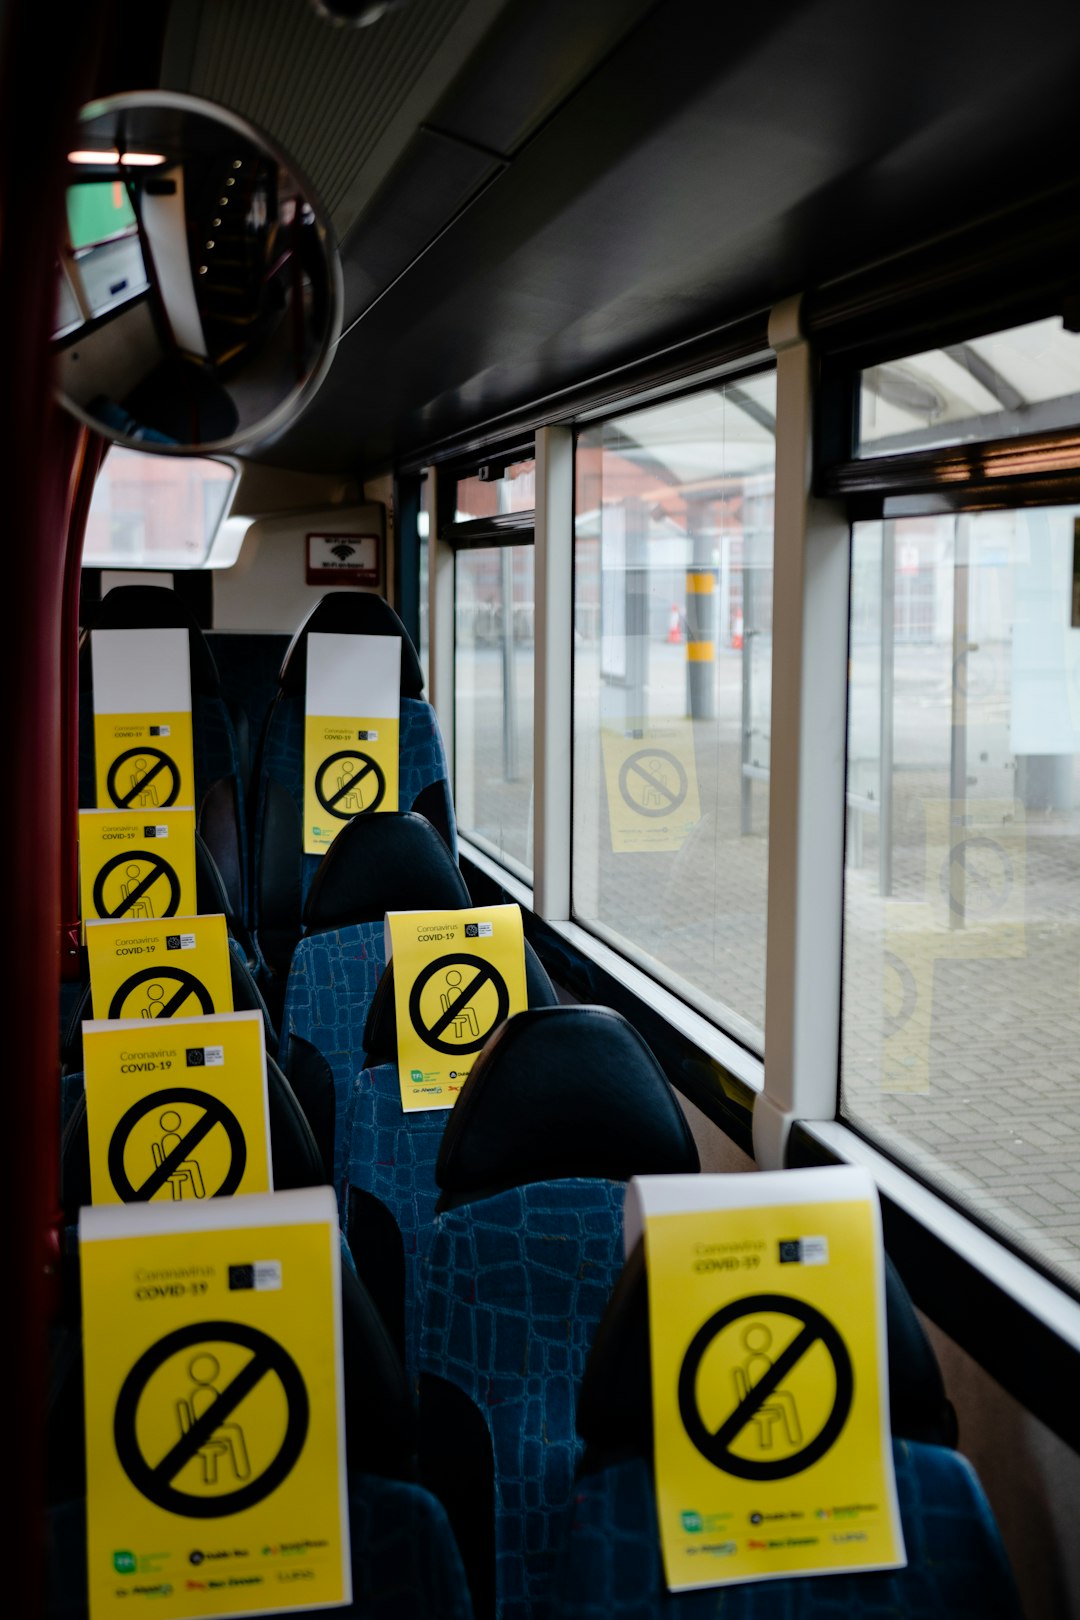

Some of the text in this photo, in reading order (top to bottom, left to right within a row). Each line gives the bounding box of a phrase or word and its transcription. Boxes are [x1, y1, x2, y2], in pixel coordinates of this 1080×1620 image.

[417, 923, 458, 933] Coronavirus
[115, 935, 160, 947] Coronavirus
[417, 932, 455, 942] COVID-19
[116, 945, 156, 956] COVID-19
[120, 1048, 177, 1061] Coronavirus
[120, 1060, 172, 1074] COVID-19
[694, 1253, 761, 1275] COVID-19
[135, 1264, 215, 1283] Coronavirus
[135, 1281, 209, 1301] COVID-19
